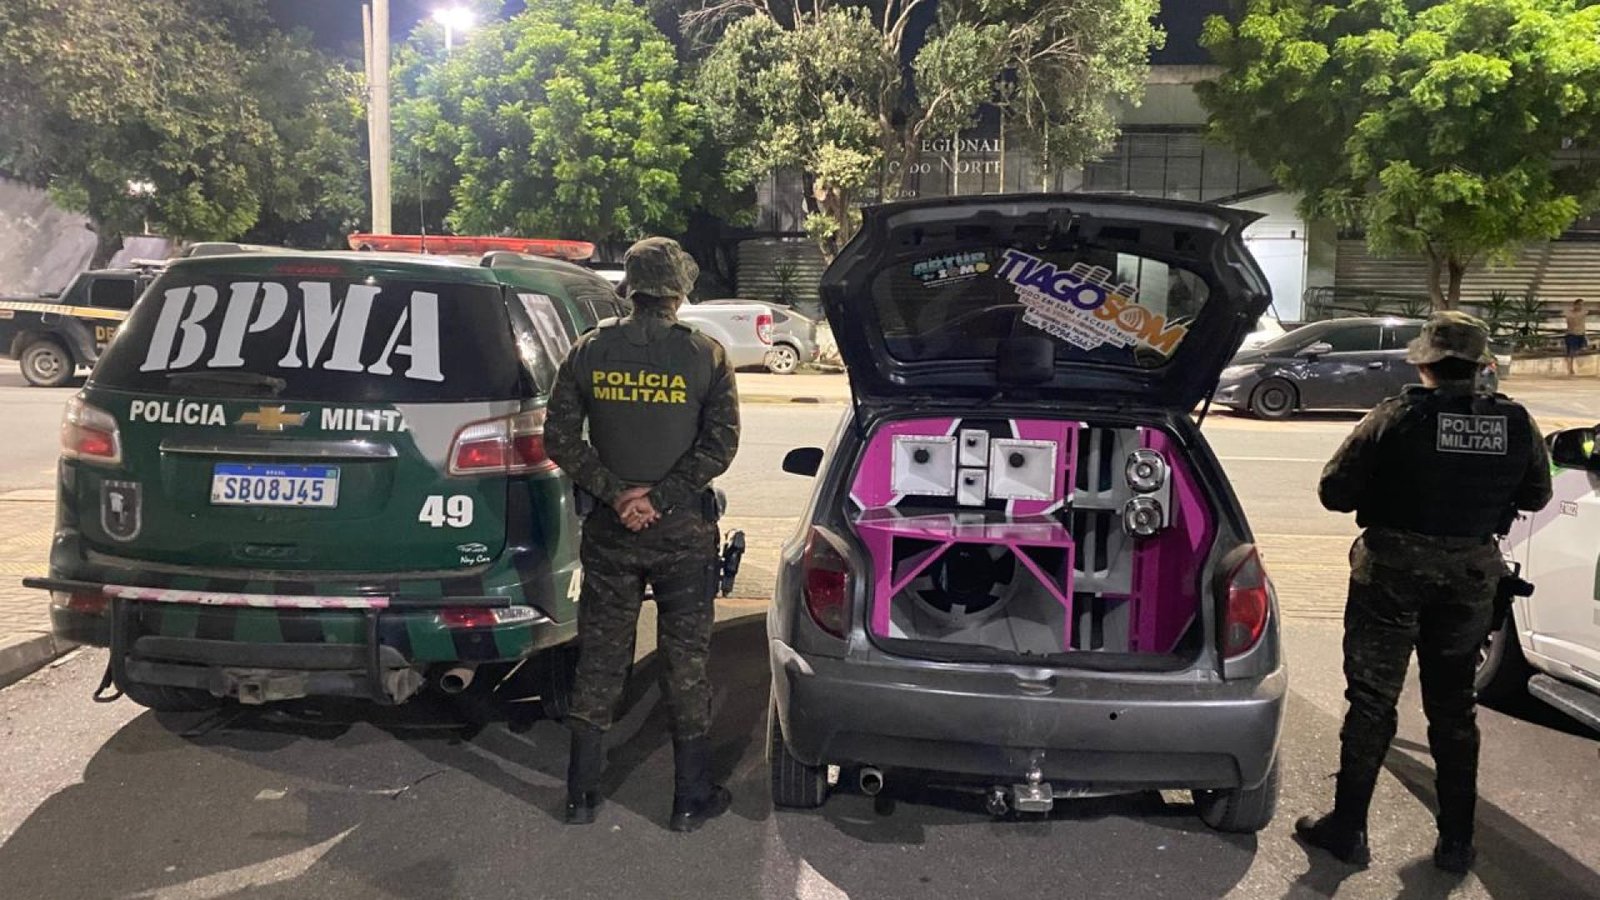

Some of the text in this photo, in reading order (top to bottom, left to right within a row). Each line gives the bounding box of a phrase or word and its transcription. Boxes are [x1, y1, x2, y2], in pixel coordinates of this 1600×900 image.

[921, 139, 1000, 152] EGIONAL
[139, 281, 445, 382] BPMA
[592, 370, 686, 389] POLÍCIA
[593, 387, 686, 403] MILITAR
[129, 399, 409, 432] POLÍCIA MILIT
[1440, 433, 1503, 450] MILITAR
[418, 494, 474, 528] 49
[567, 567, 584, 602] 4
